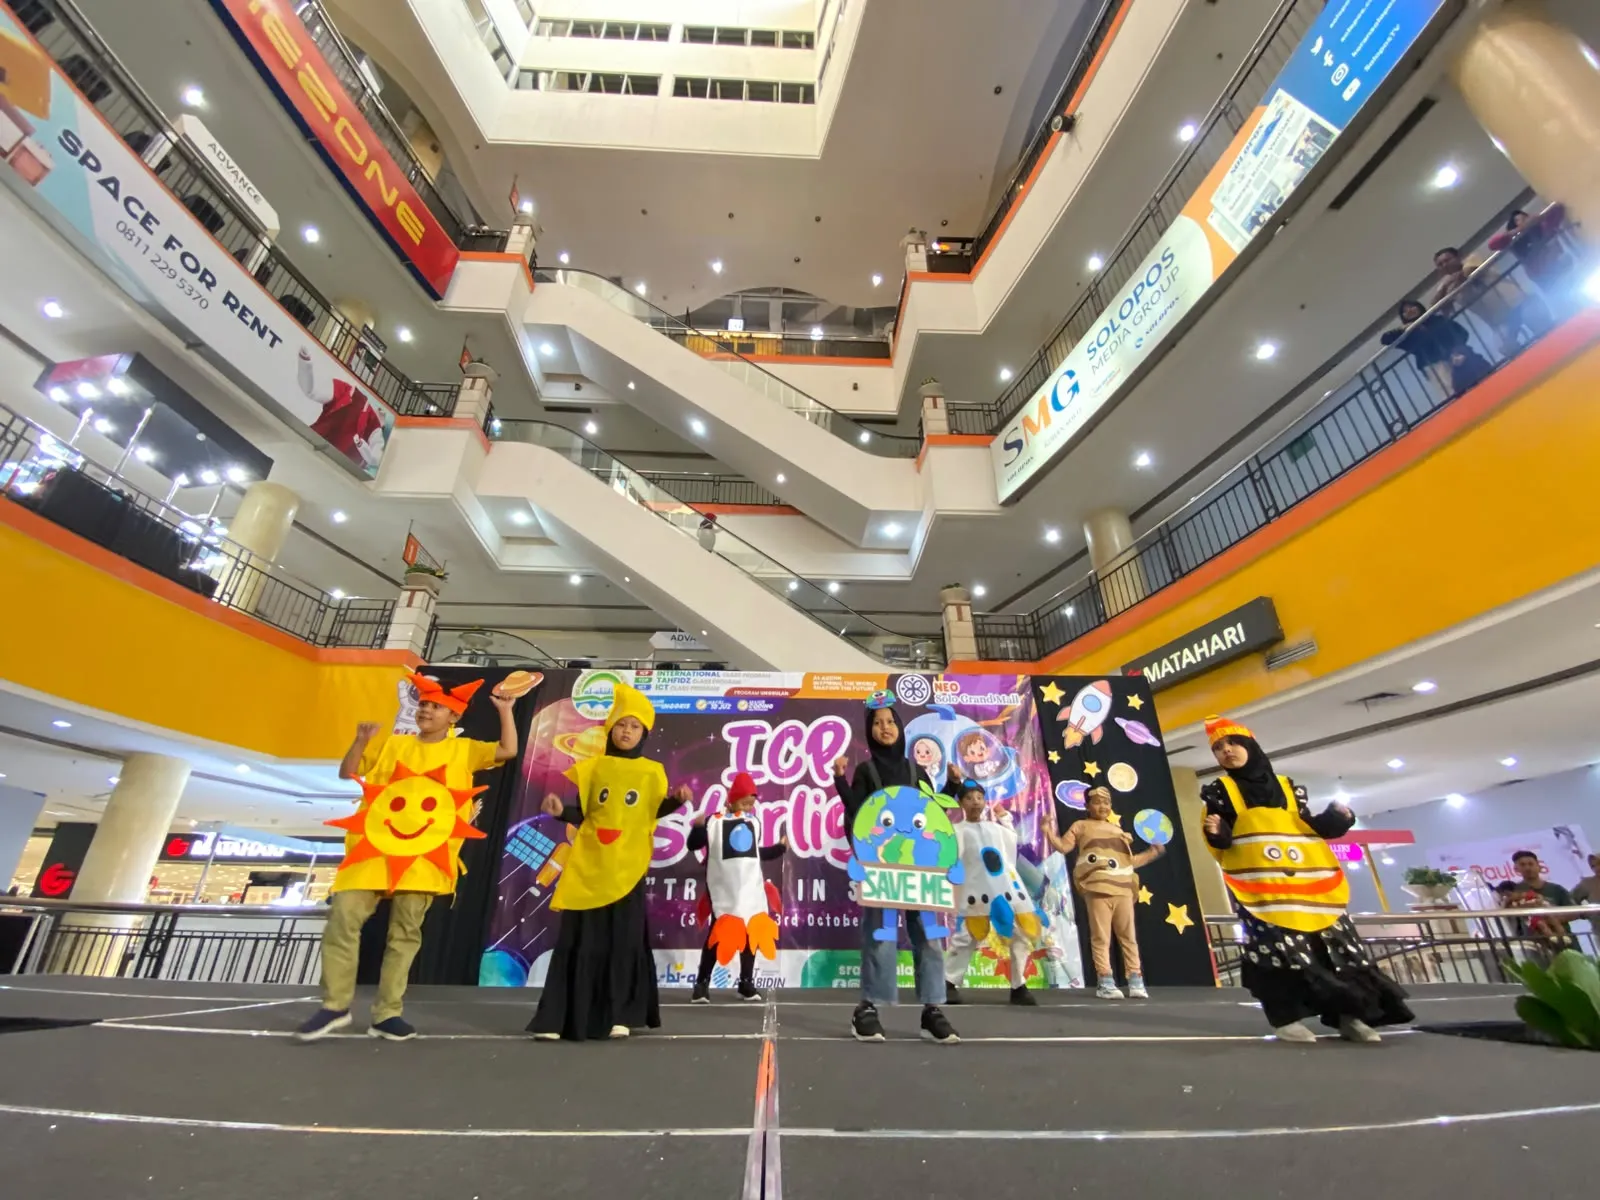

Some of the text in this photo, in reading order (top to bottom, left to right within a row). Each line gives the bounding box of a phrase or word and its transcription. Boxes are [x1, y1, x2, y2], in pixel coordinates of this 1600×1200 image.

[206, 140, 262, 206] ADVANCE
[57, 128, 161, 236] SPACE
[164, 234, 218, 293] FOR
[222, 289, 283, 349] RENT
[116, 219, 210, 311] 0811 229 5370
[1086, 246, 1176, 361] SOLOPOS
[1091, 327, 1132, 375] MEDIA
[1132, 265, 1180, 327] GROUP
[1003, 369, 1080, 468] SMG
[1143, 623, 1247, 684] MATAHARI
[934, 682, 959, 692] NEO
[935, 694, 958, 704] Solo
[724, 718, 849, 785] ICP
[797, 878, 826, 901] IN
[807, 911, 859, 928] Octobe
[863, 870, 917, 903] SAVE
[920, 872, 953, 906] ME
